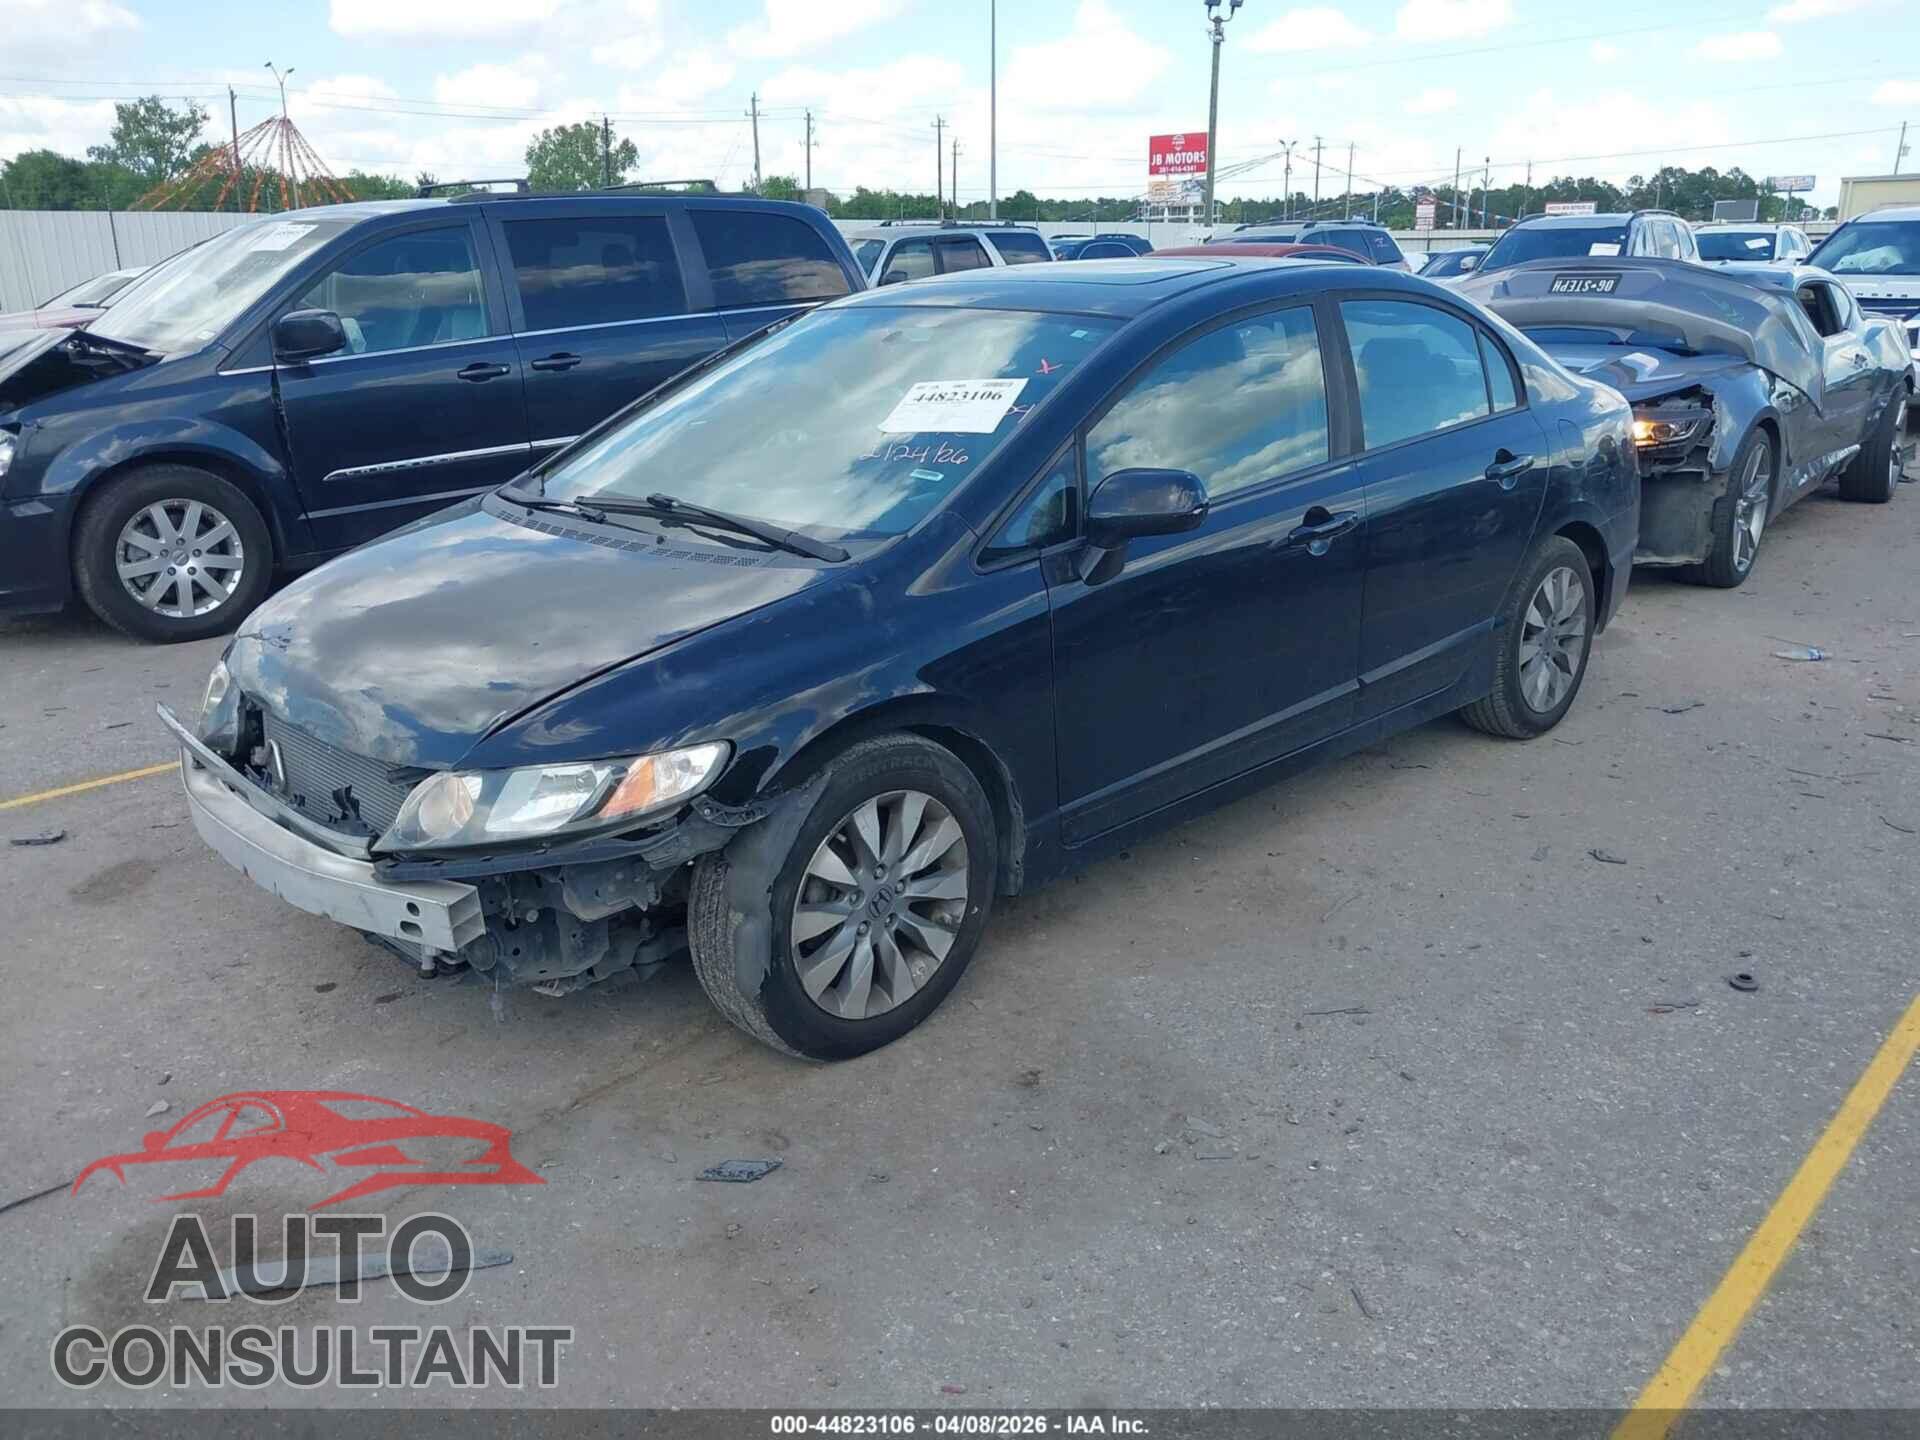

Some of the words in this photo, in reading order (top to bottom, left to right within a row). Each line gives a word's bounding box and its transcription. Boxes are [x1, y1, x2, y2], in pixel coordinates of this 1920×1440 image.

[1152, 154, 1162, 166] JB
[1165, 151, 1205, 165] MOTORS
[913, 390, 1003, 402] 44823106
